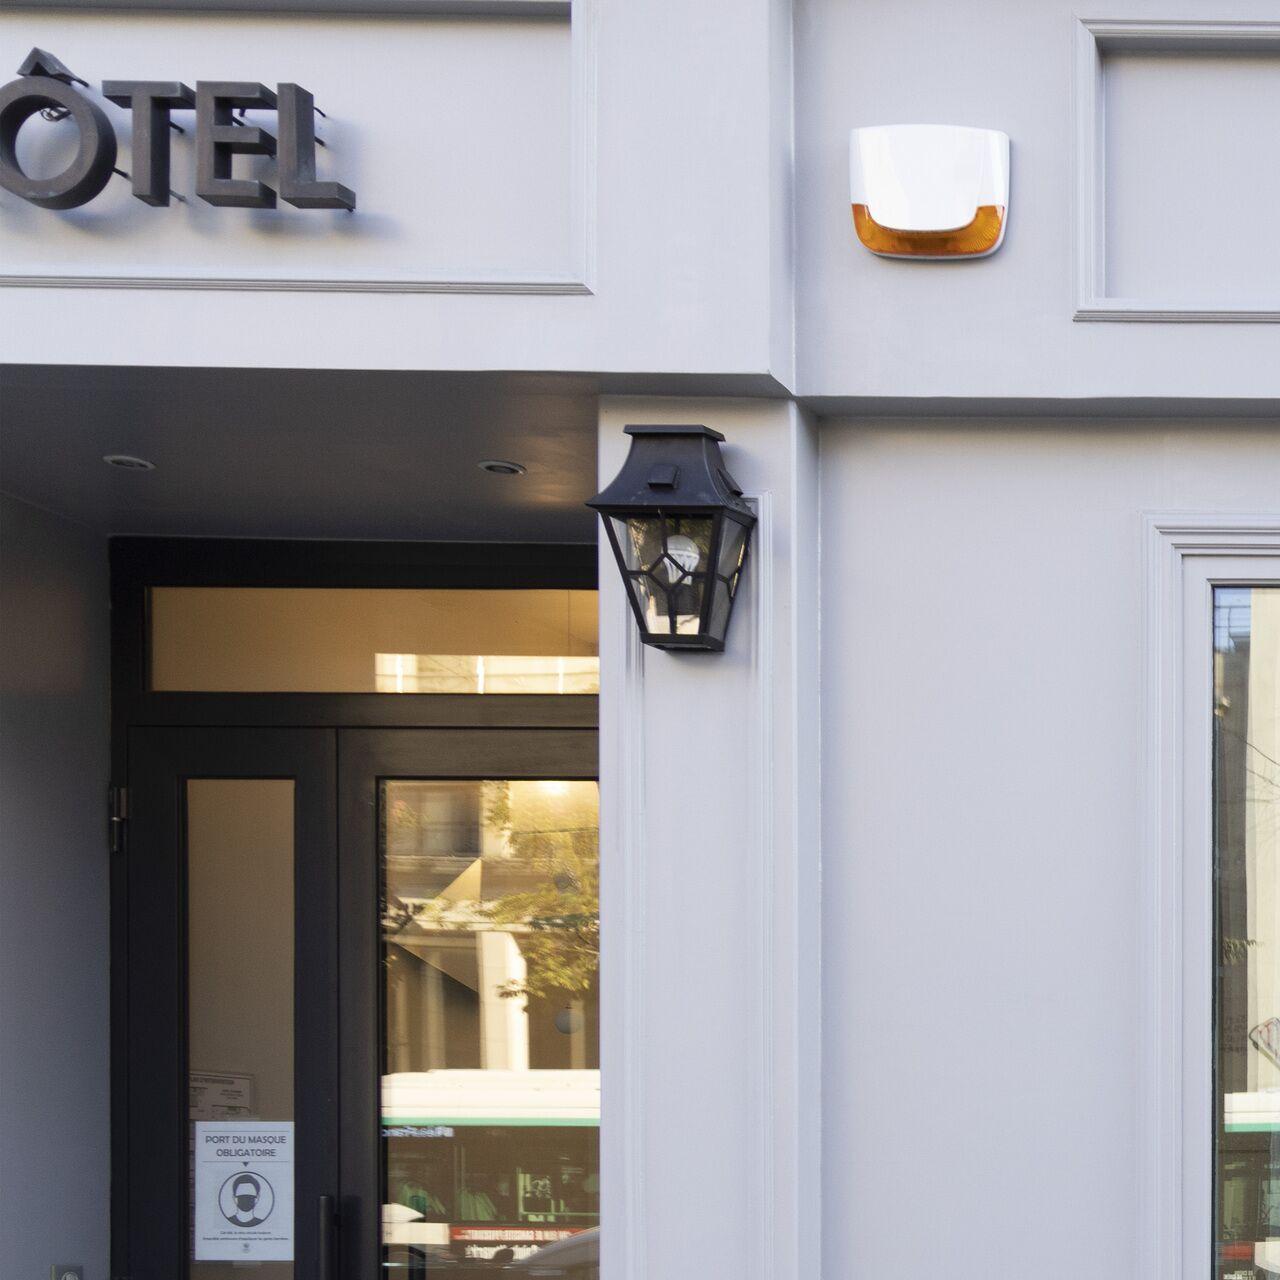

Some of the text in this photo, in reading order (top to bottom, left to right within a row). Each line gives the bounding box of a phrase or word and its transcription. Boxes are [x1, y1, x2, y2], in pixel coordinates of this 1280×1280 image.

[205, 1135, 287, 1145] PORT DU MASQUE
[216, 1148, 277, 1157] OBLIGATOIRE
